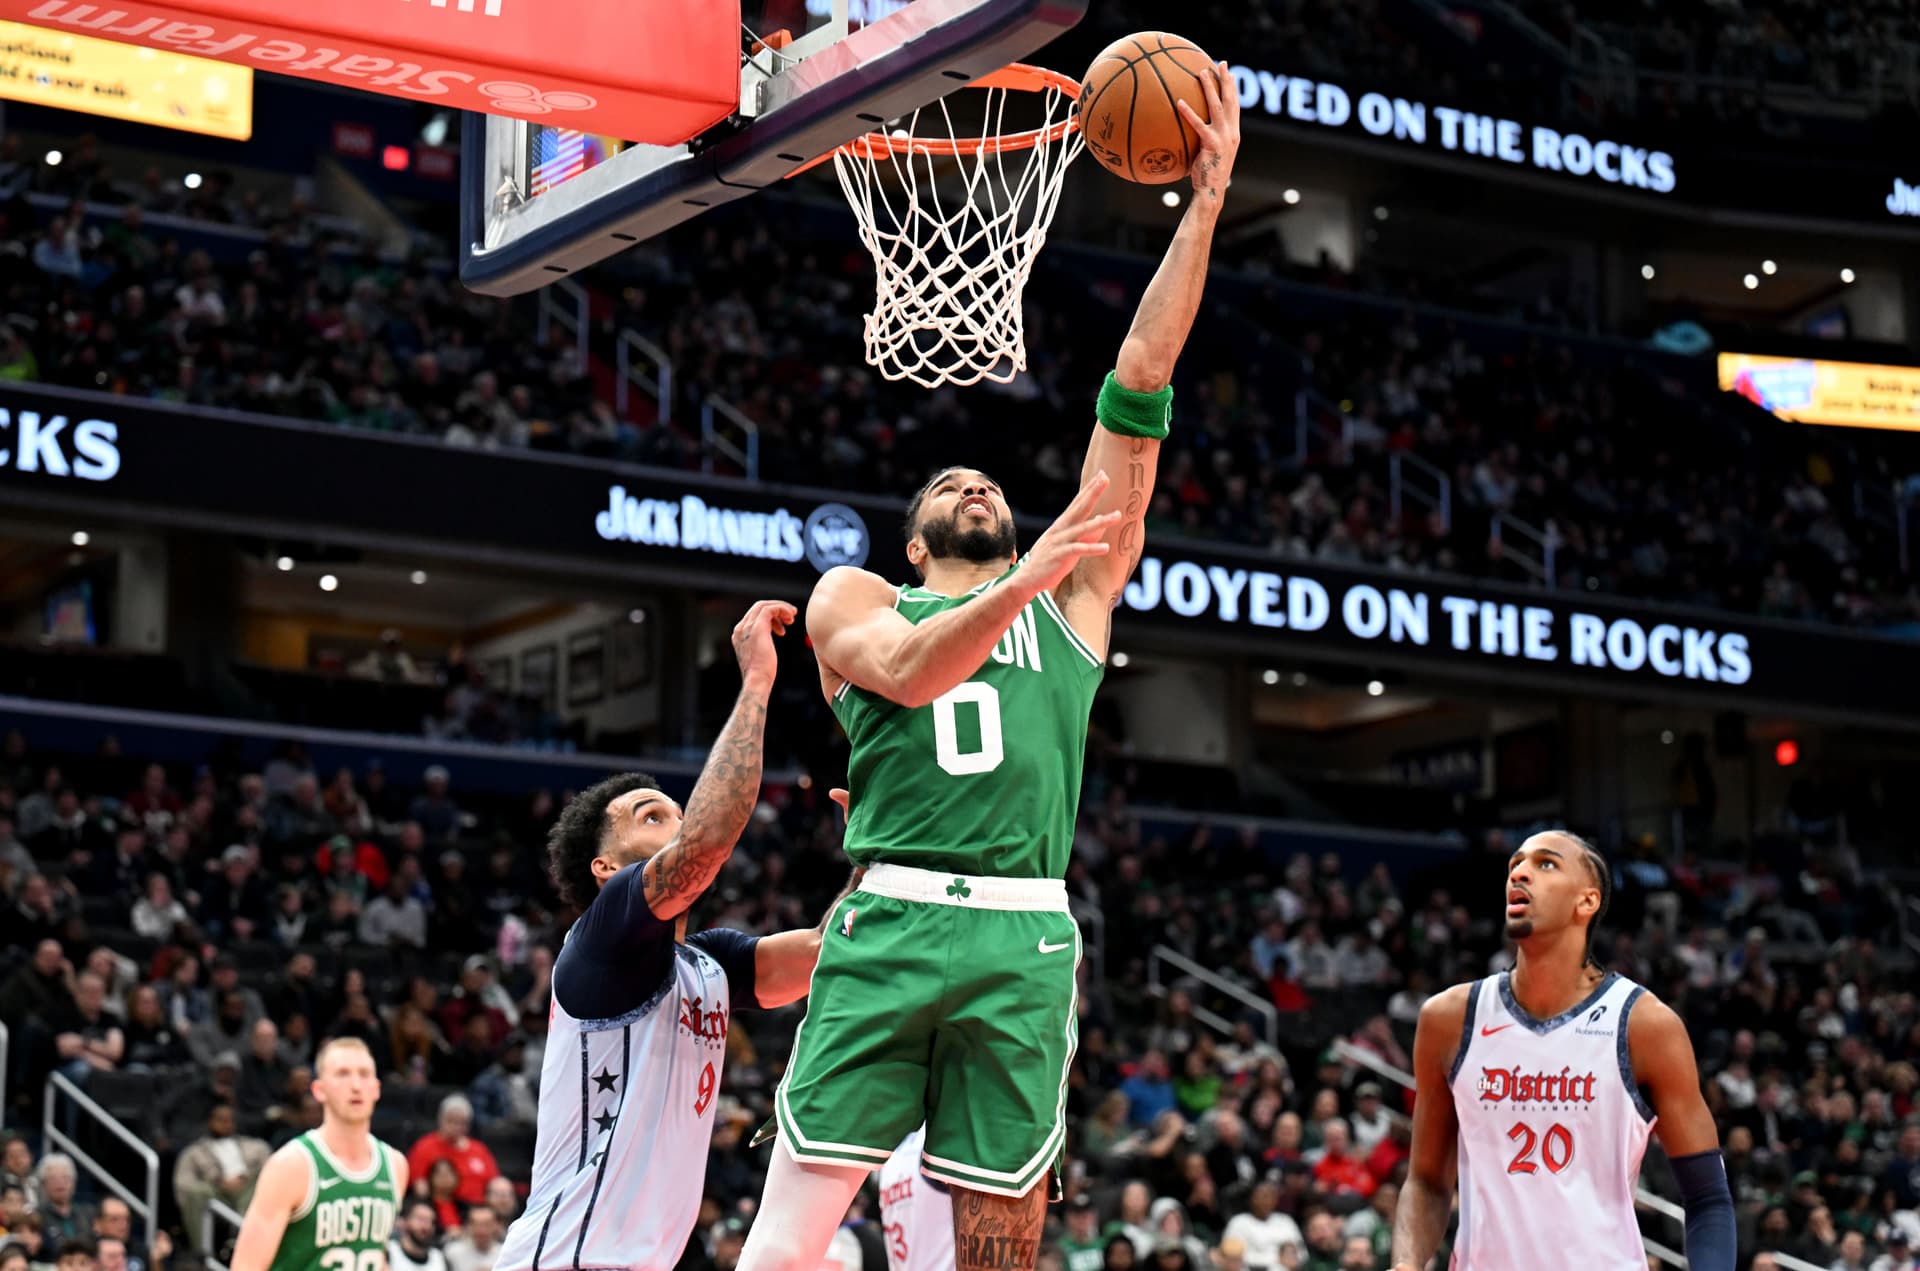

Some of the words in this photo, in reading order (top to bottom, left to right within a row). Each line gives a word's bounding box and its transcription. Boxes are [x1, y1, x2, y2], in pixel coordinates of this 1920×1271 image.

[1228, 65, 1350, 126] OYED
[1358, 92, 1426, 144] ON
[1433, 105, 1525, 164] THE
[1531, 126, 1677, 193] ROCKS
[991, 602, 1042, 672] ON
[1117, 557, 1330, 631] JOYED
[1342, 584, 1430, 645] ON
[1441, 596, 1558, 661] THE
[1569, 612, 1752, 684] ROCKS
[932, 681, 1004, 775] 0
[694, 1061, 716, 1119] 9
[1480, 1065, 1596, 1102] District
[1507, 1121, 1575, 1174] 20
